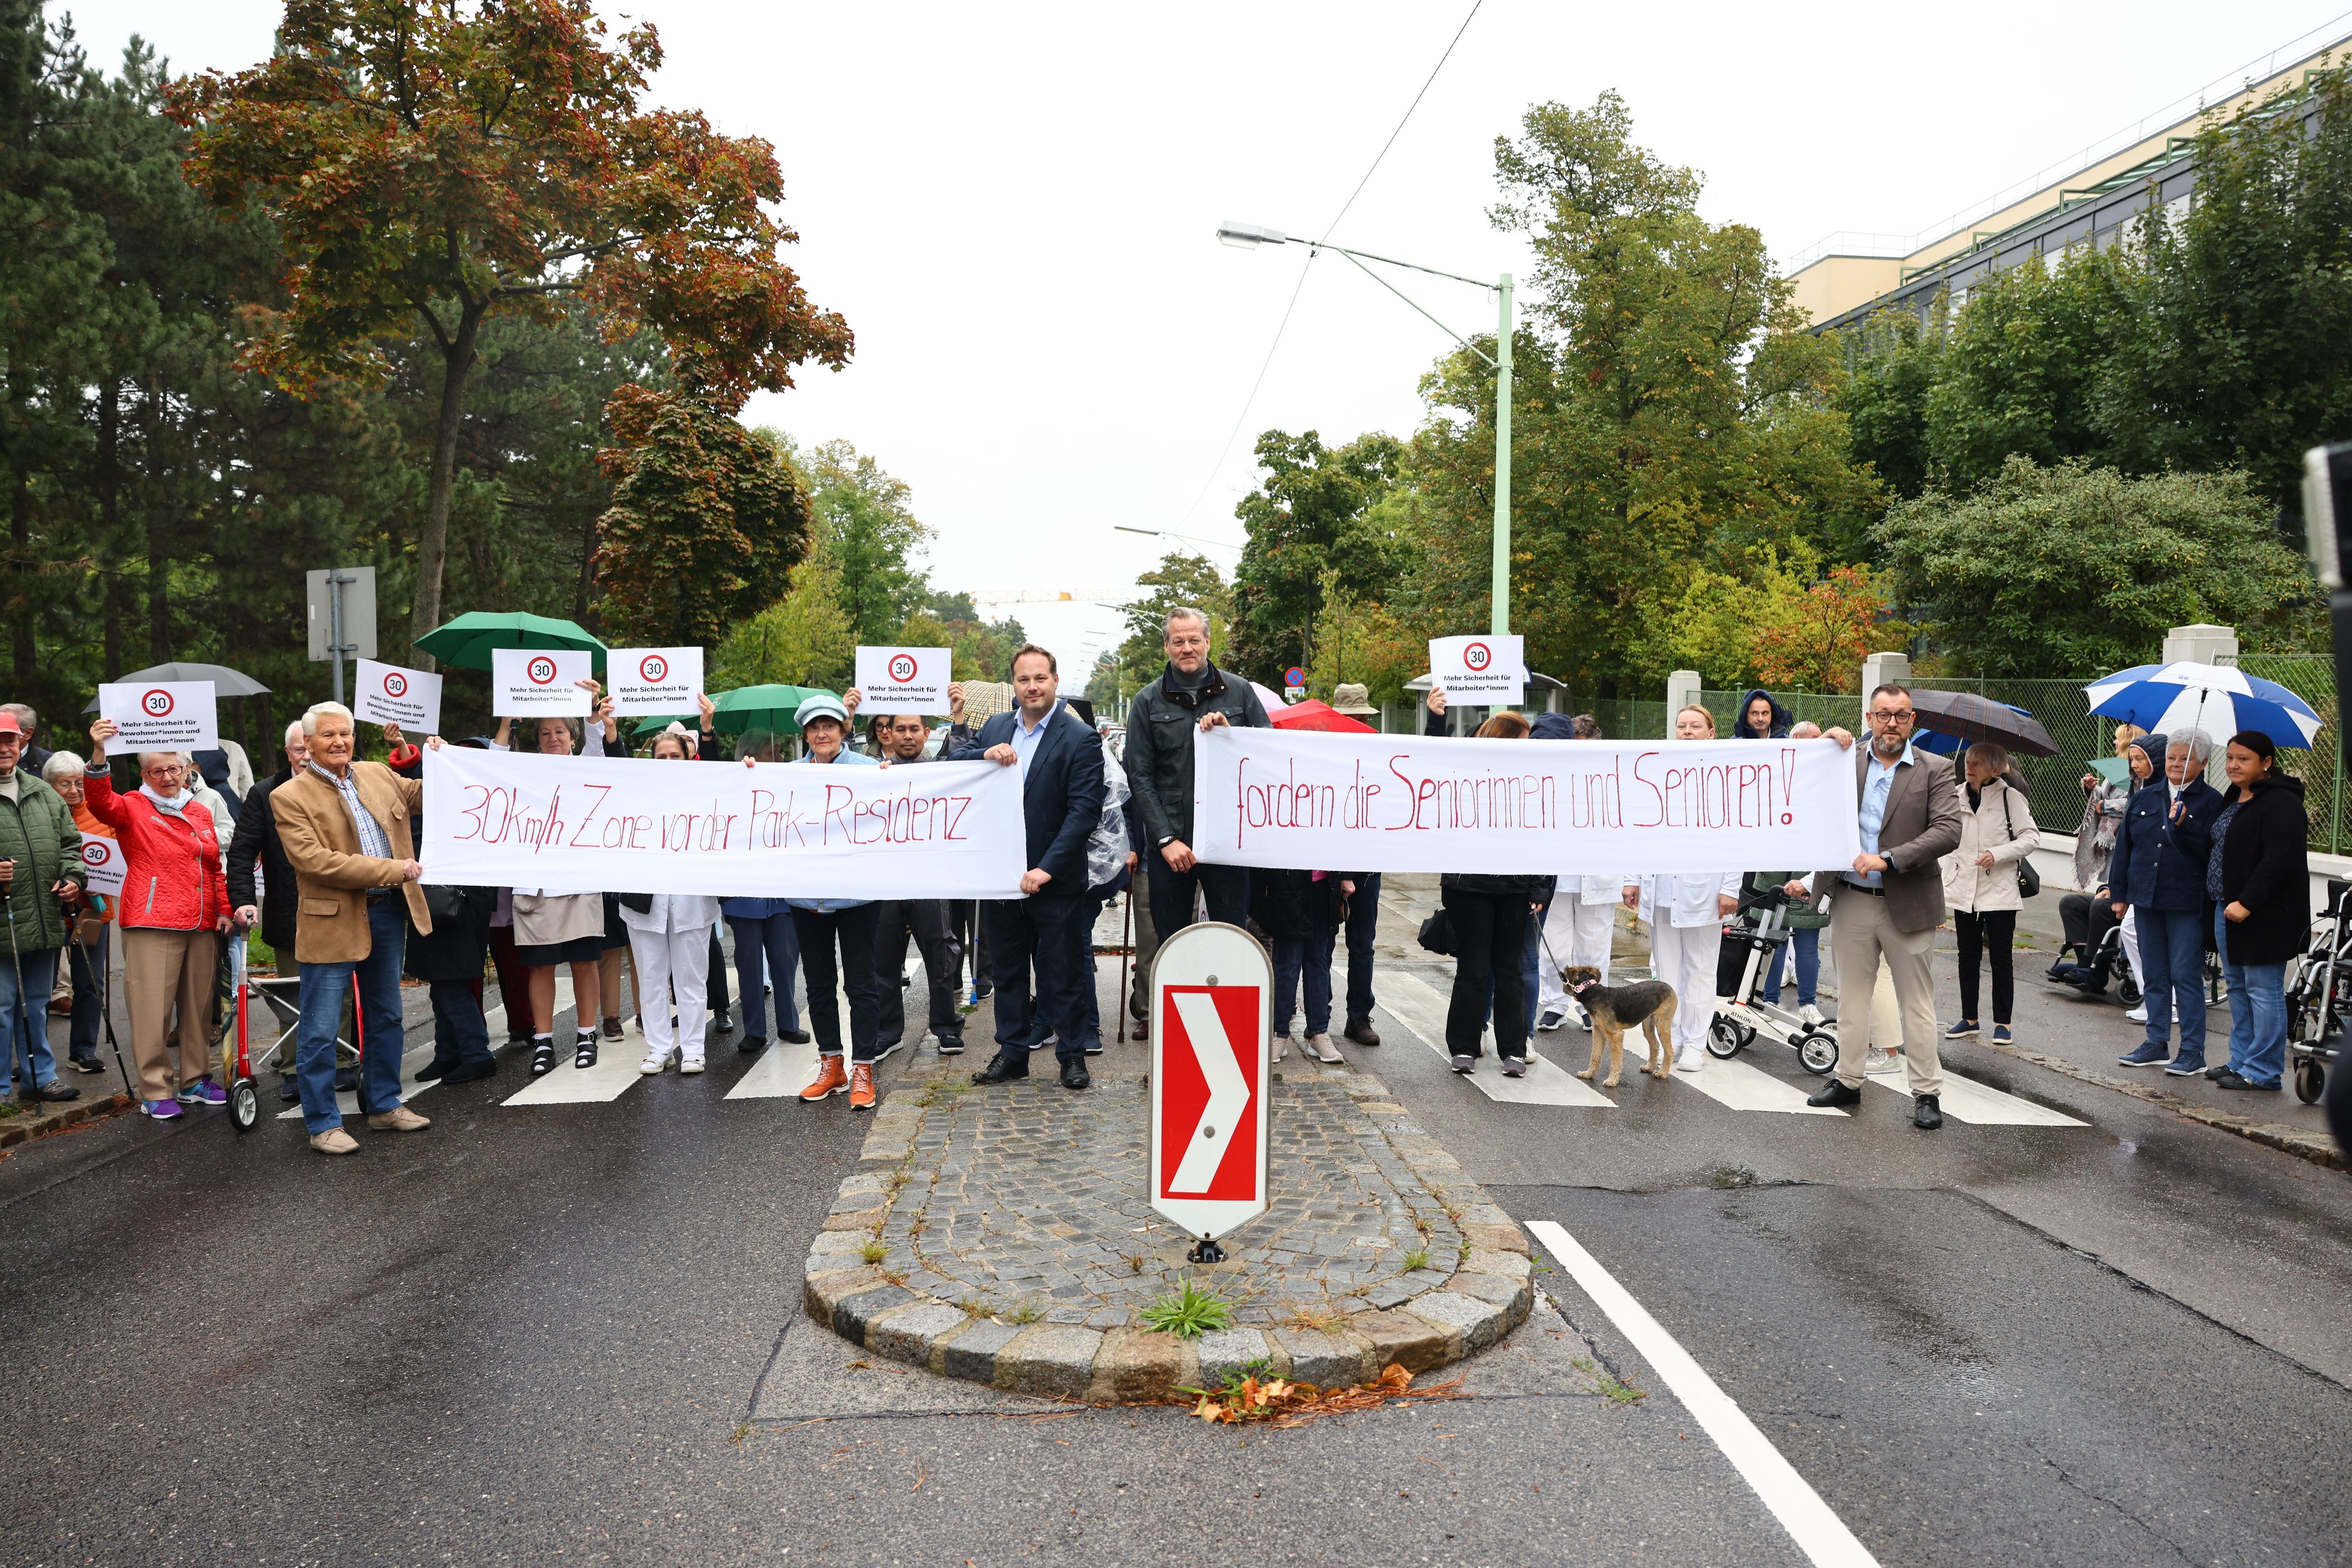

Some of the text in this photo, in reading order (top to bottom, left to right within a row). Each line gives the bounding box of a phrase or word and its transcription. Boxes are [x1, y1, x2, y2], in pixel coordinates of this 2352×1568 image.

[1471, 651, 1484, 663] 30
[535, 665, 549, 676] 30
[647, 663, 661, 674] 30
[896, 663, 910, 674] 30
[389, 680, 402, 691] 30
[149, 697, 166, 709] 30
[383, 698, 412, 709] Sicherheit
[1238, 748, 1796, 850] fordern die Seniorinnen und Senioren!
[569, 784, 653, 848] Zone
[749, 781, 971, 850] Park-Residenz
[86, 848, 103, 860] 30
[87, 867, 112, 875] herheit
[1730, 1011, 1752, 1024] ATHLON
